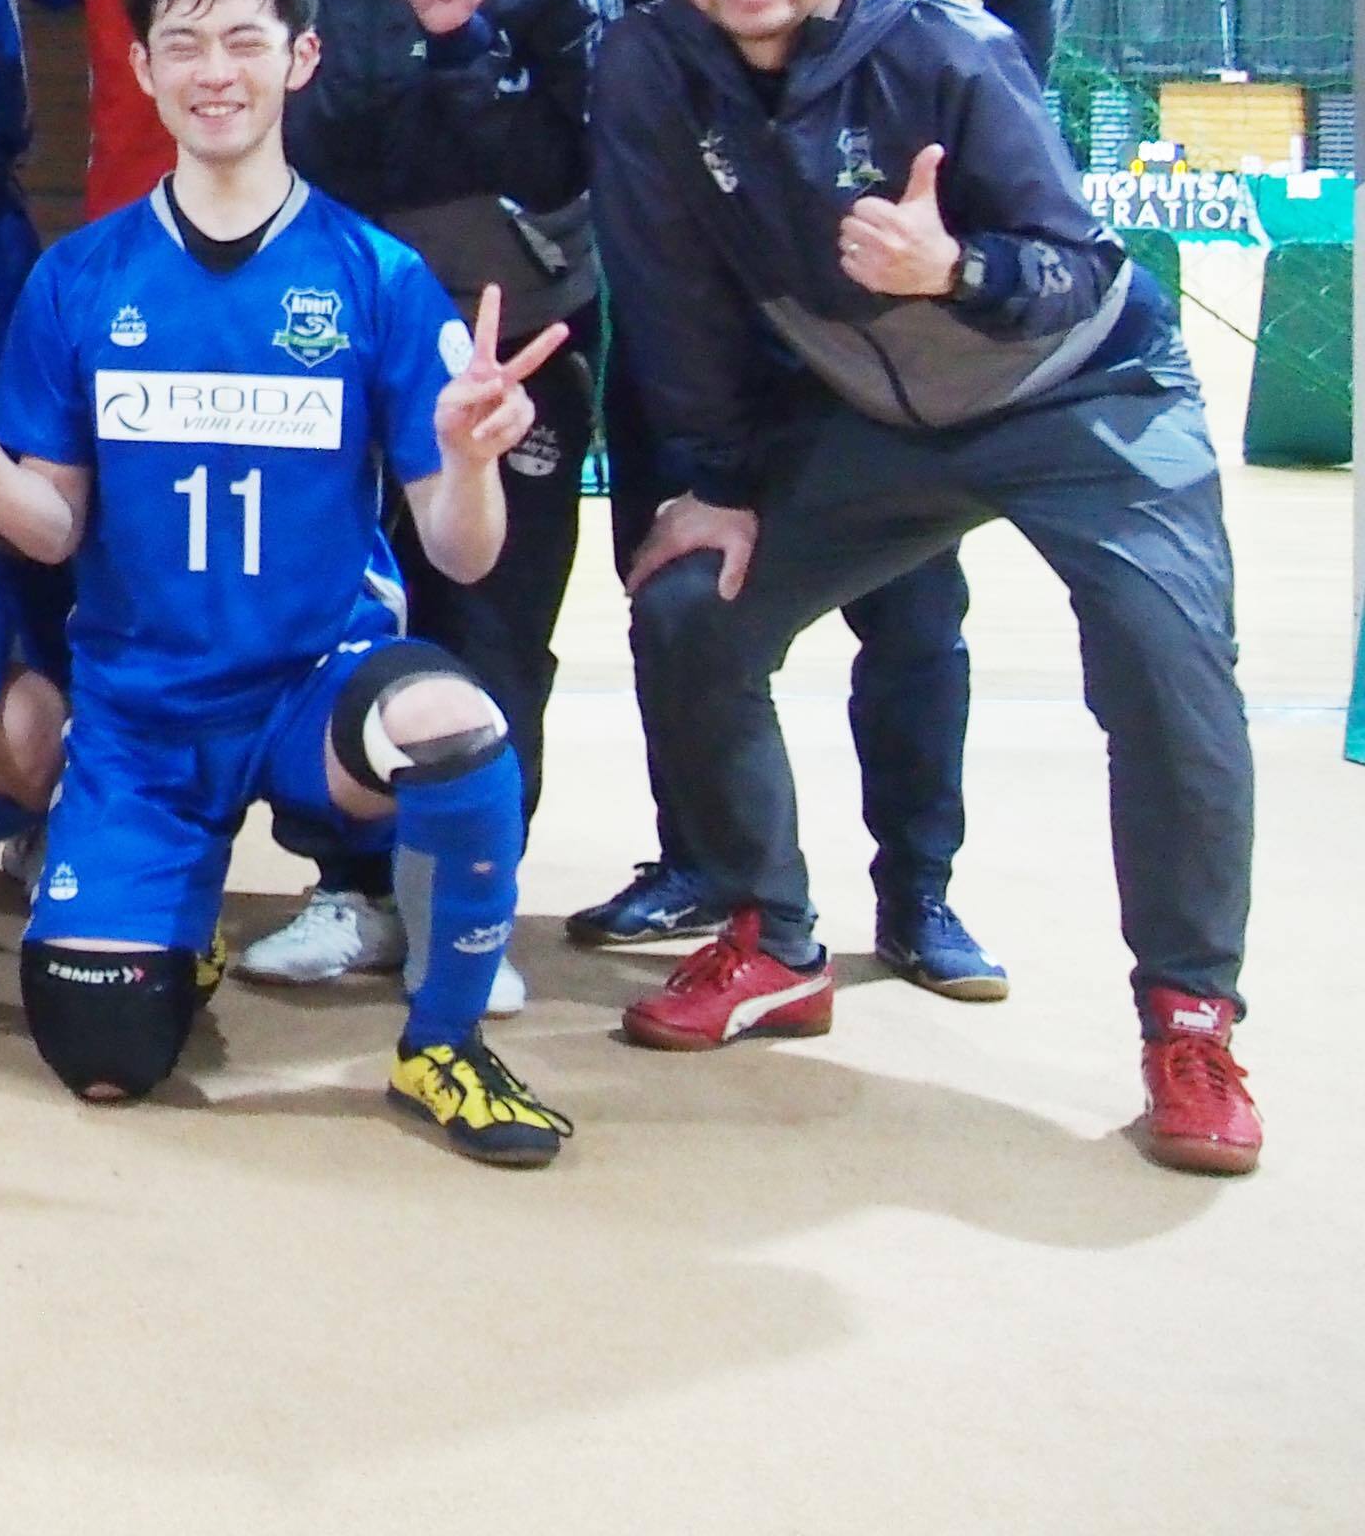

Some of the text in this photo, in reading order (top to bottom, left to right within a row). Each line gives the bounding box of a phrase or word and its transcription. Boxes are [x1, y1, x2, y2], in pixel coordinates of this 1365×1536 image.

[1140, 172, 1247, 202] FUTSA
[170, 385, 333, 418] RODA
[174, 464, 262, 576] 11
